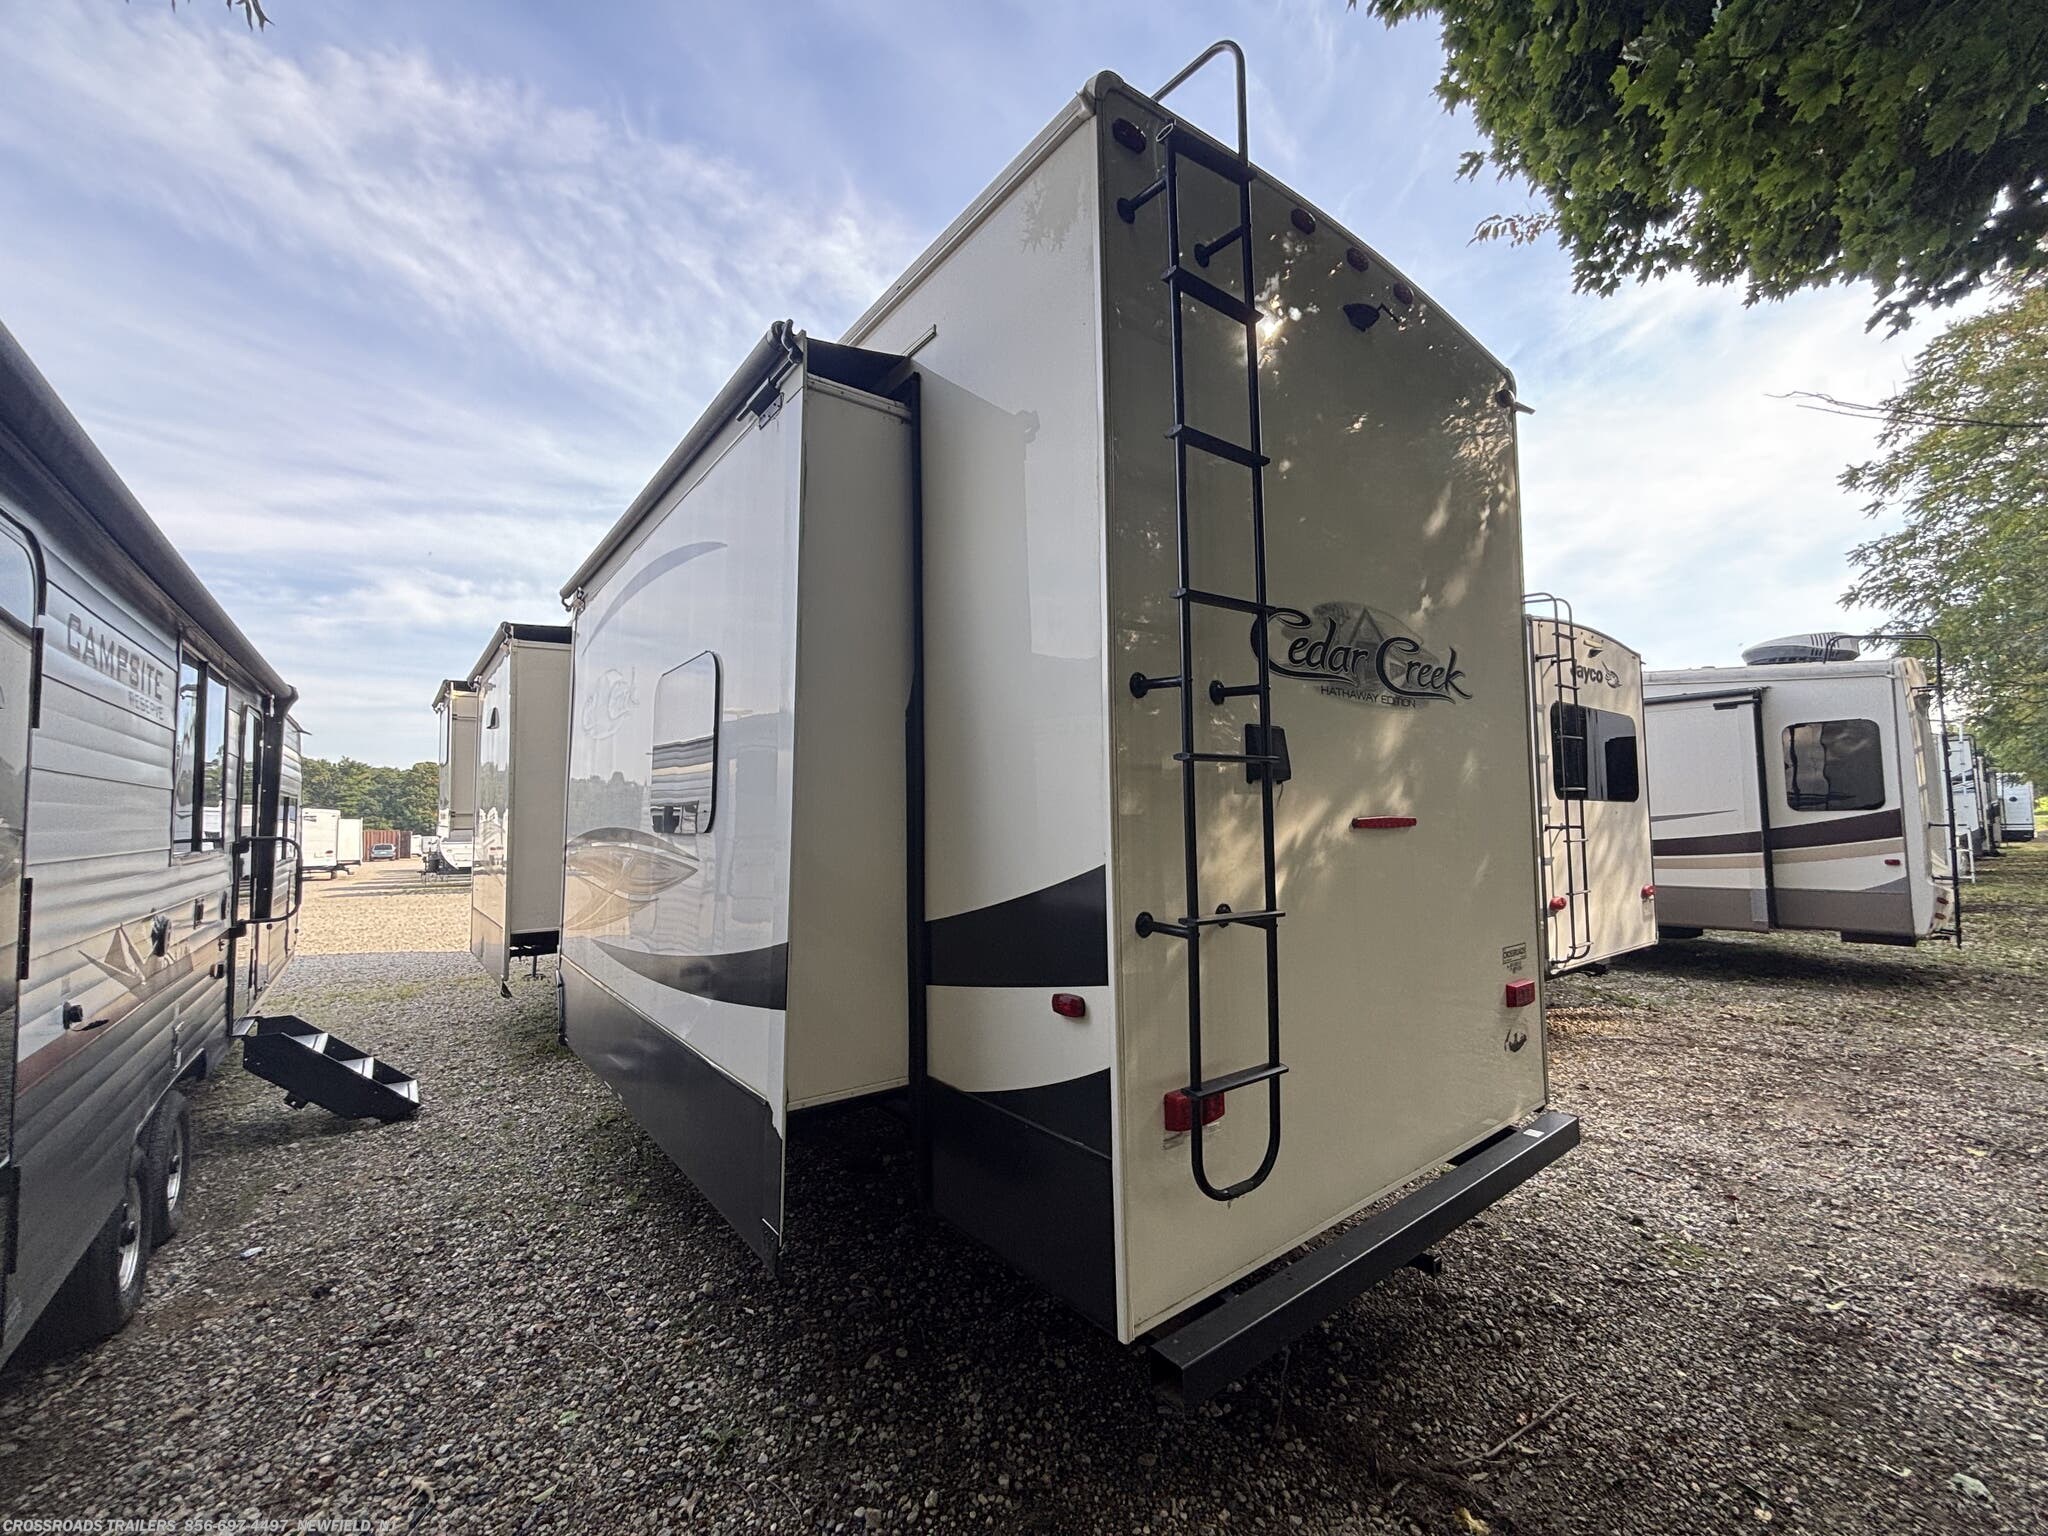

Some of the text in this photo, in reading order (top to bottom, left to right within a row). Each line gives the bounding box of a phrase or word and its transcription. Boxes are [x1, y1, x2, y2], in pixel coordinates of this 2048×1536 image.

[67, 612, 164, 701] CAMPSITE
[1251, 607, 1473, 705] Cedar Creek
[1570, 660, 1603, 685] ayco
[1320, 685, 1416, 708] HATHAWAY EDITION
